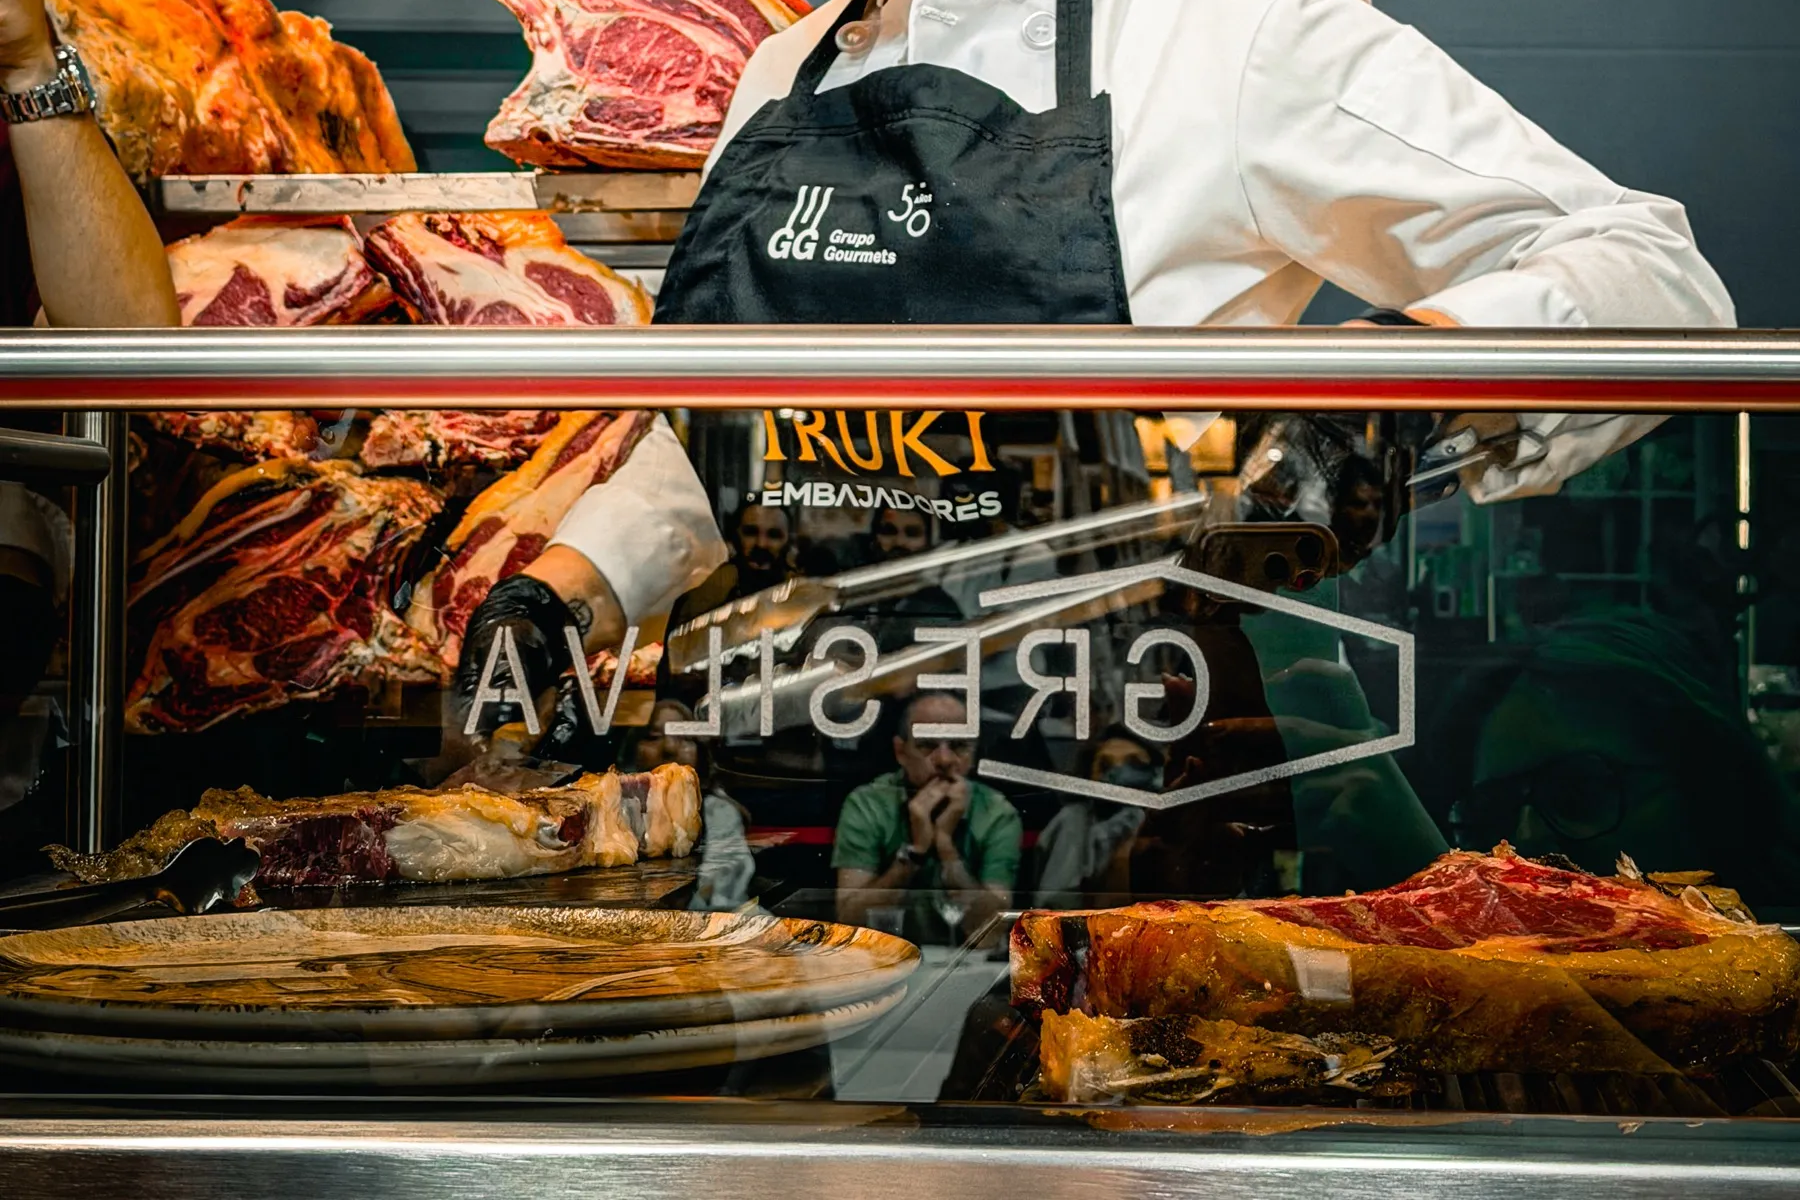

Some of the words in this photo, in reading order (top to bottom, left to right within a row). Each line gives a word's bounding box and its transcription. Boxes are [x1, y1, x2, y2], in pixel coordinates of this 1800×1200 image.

[829, 229, 876, 246] Grupo
[823, 245, 898, 265] Gourmets
[761, 479, 1003, 523] EMBAJADORES
